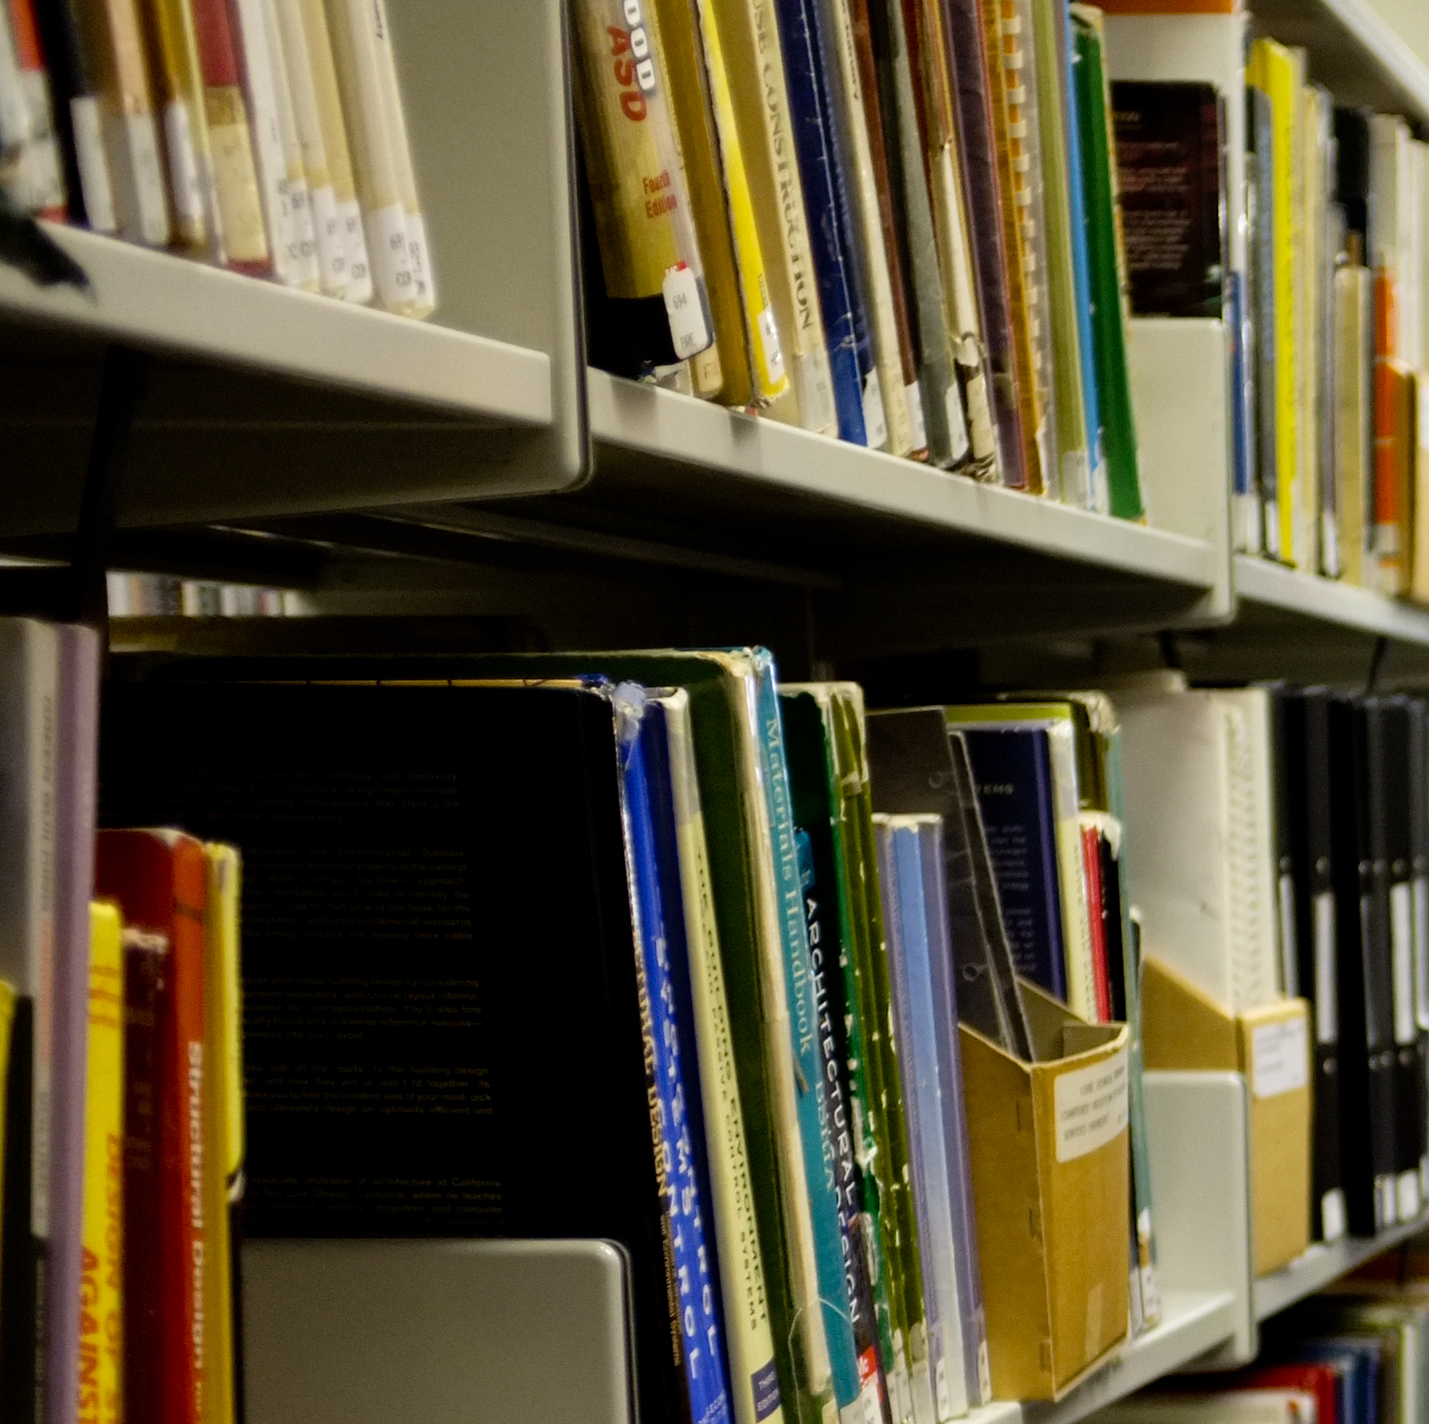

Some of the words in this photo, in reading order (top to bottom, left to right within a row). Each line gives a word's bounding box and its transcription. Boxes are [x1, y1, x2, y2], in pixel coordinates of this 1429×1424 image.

[607, 26, 648, 123] ASD
[762, 63, 814, 330] CONSTRUCTION
[765, 718, 798, 881] Materials
[784, 889, 816, 1056] Handbook
[804, 896, 858, 1207] ARCHITECTURAL
[731, 1097, 768, 1322] ENVIRONMENT
[738, 1231, 758, 1331] SYSTEMS
